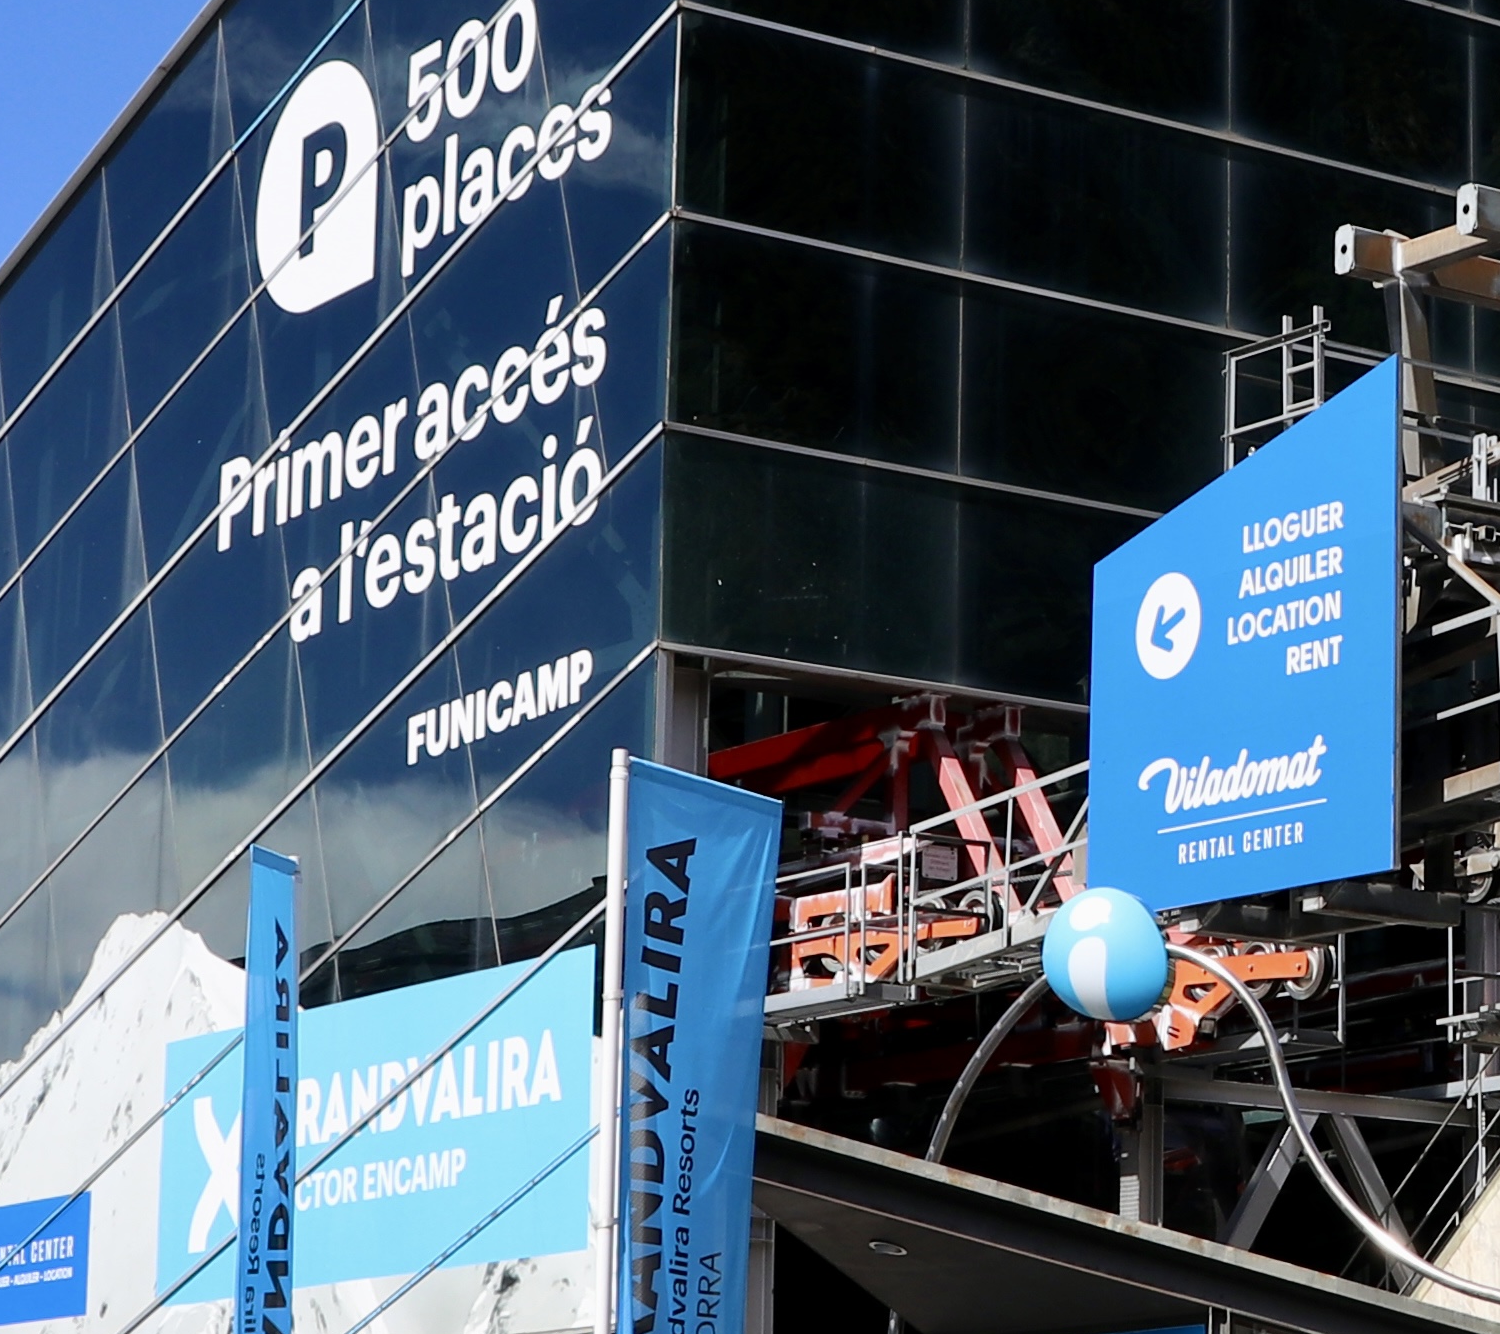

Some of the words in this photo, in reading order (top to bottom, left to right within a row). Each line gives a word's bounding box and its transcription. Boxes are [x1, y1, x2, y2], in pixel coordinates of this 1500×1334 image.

[401, 81, 613, 277] places
[216, 392, 409, 553] Primer
[414, 294, 607, 456] accés
[290, 565, 323, 643] a
[339, 416, 605, 625] l'estació
[1243, 501, 1344, 554] LLOGUER
[1239, 545, 1343, 599] ALQUILER
[1226, 590, 1342, 645] LOCATION
[1286, 635, 1343, 676] RENT
[407, 648, 594, 766] FUNICAMP
[1138, 734, 1327, 815] Viladomat
[1178, 828, 1236, 865] RENTAL
[1243, 821, 1304, 854] CENTER
[296, 1028, 562, 1148] RANDVALIRA
[295, 1165, 357, 1212] CTOR
[363, 1148, 466, 1201] ENCAMP
[673, 1087, 700, 1217] Resorts
[31, 1236, 74, 1263] CENTER
